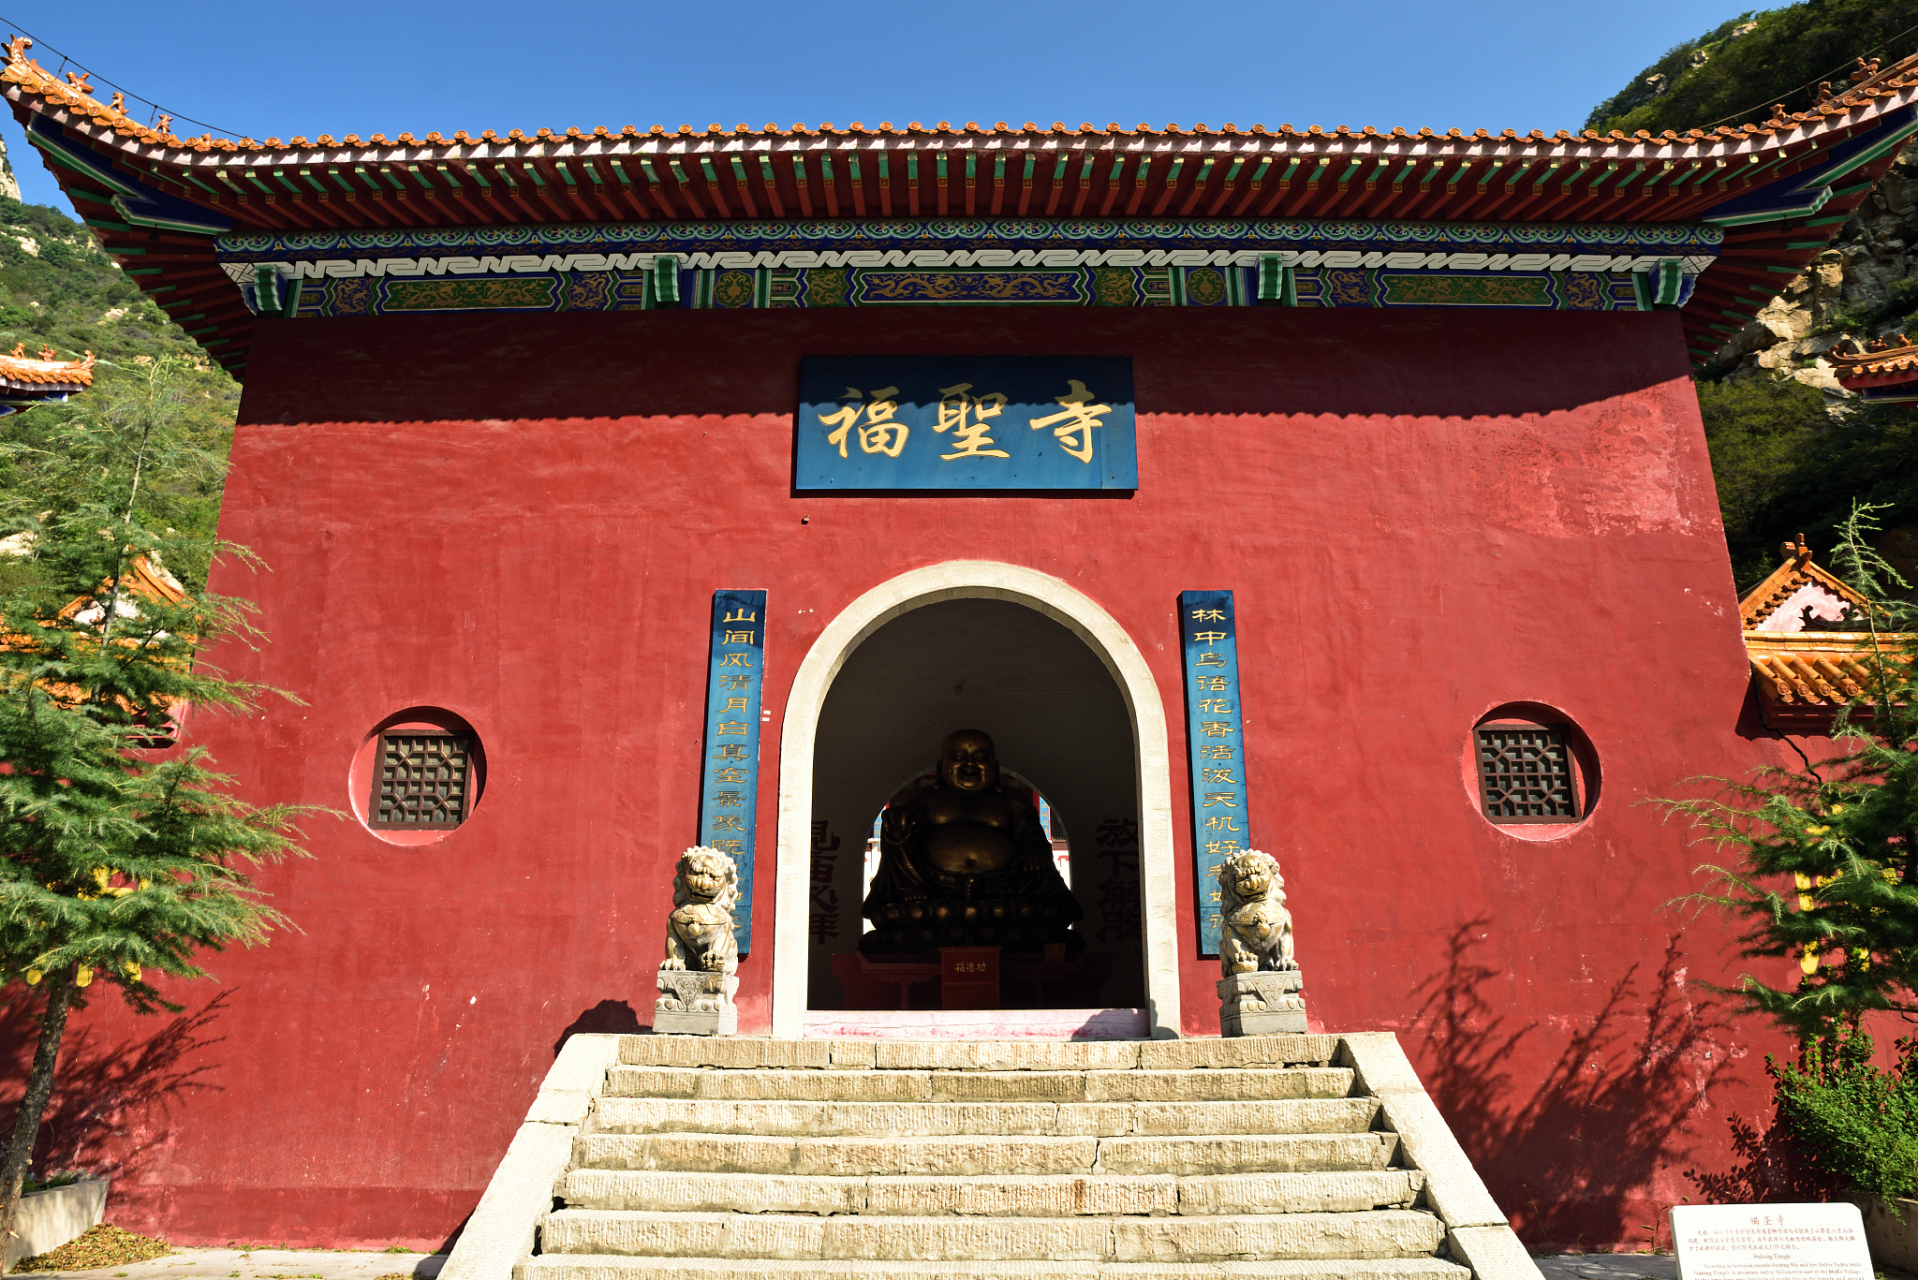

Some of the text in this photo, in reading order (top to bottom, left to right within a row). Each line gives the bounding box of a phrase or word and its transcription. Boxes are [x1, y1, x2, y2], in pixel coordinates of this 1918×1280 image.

[817, 379, 1112, 463] 福聖寺
[710, 607, 756, 929] 山间风清月白真空景象既
